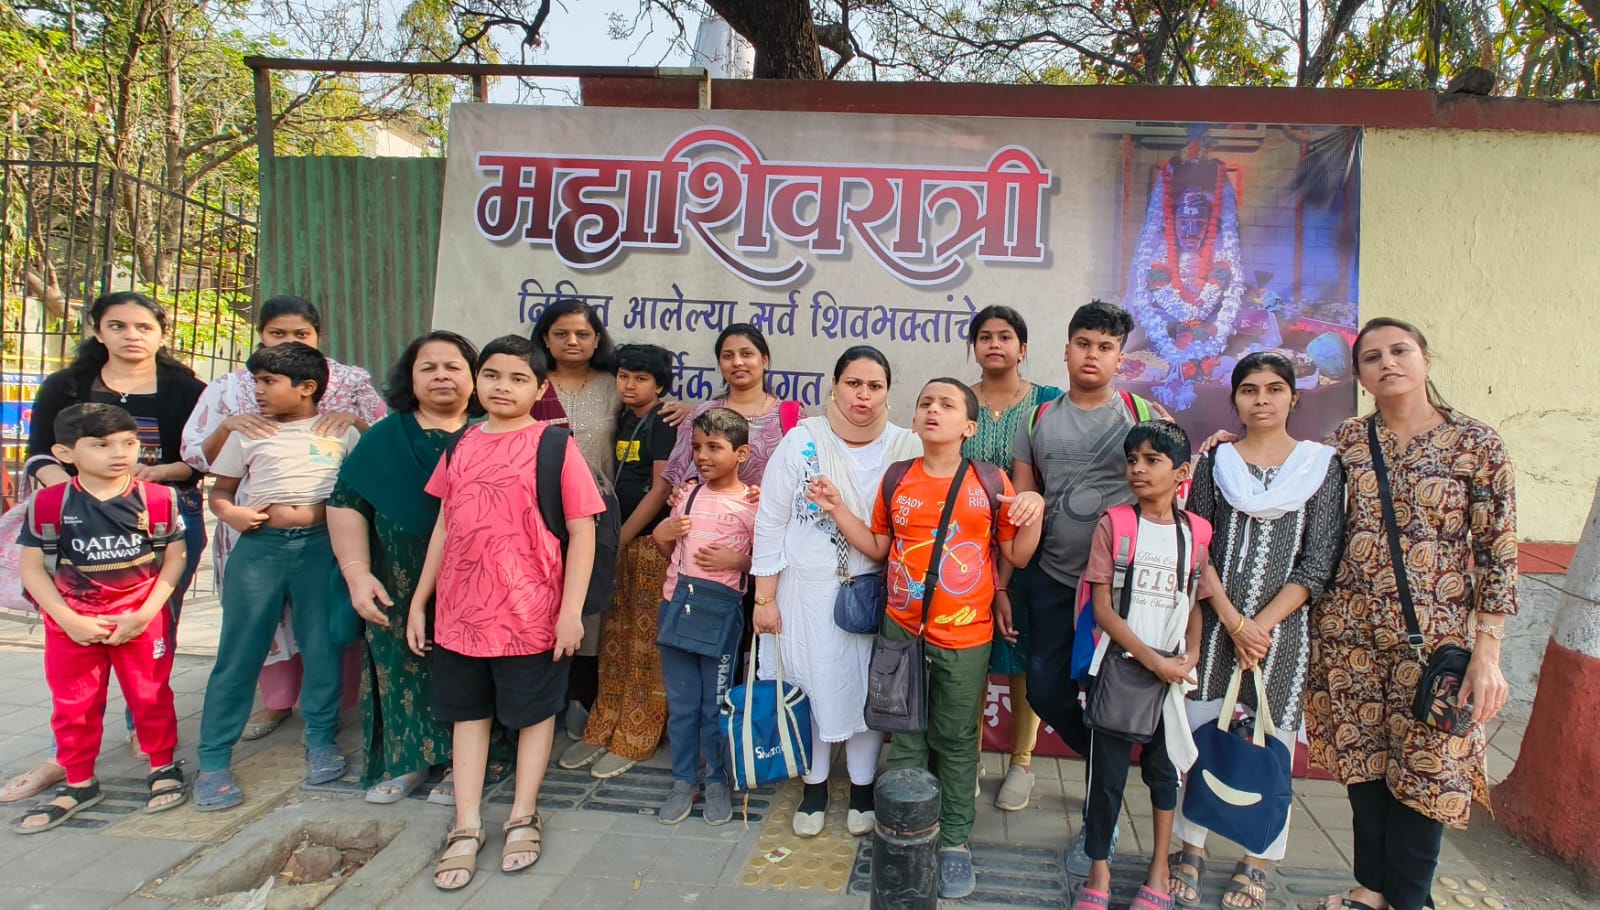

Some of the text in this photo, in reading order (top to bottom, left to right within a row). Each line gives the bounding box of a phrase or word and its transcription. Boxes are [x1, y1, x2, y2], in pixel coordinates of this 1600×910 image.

[475, 124, 1053, 286] महाशिवरात्री
[623, 283, 738, 333] आलेल्या
[896, 495, 924, 509] READY
[898, 505, 910, 516] TO
[894, 514, 908, 526] GO!
[71, 533, 143, 554] QATAR
[86, 545, 141, 561] AIRWAYS
